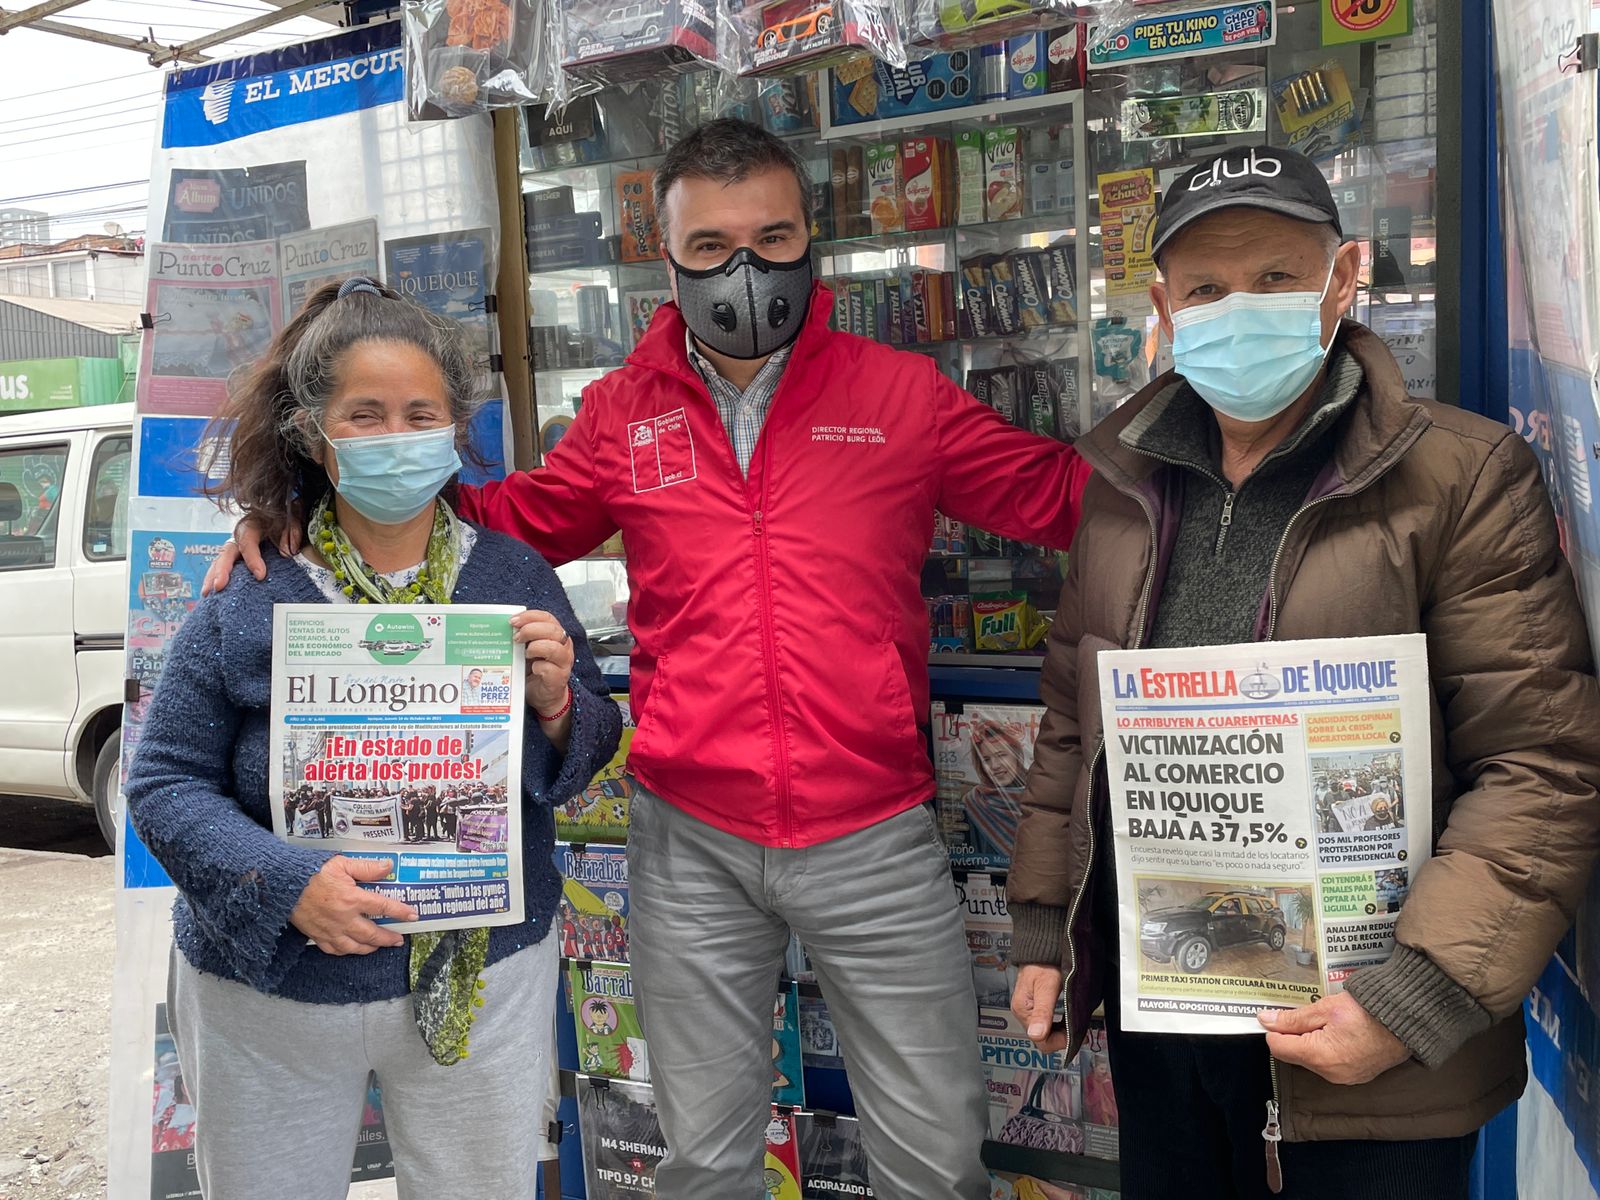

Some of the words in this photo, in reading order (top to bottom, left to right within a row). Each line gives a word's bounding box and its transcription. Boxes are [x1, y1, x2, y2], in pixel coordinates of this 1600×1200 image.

[1225, 10, 1254, 25] CHAO
[1135, 24, 1163, 39] PIDE
[1166, 21, 1182, 34] TU
[1186, 16, 1217, 31] KINO
[1228, 18, 1254, 33] JEFE
[1150, 37, 1166, 49] EN
[1169, 33, 1203, 46] CAJA
[245, 81, 279, 103] EL
[1188, 149, 1281, 191] club
[230, 181, 297, 210] UNIDOS
[633, 201, 648, 253] ROCKLETS
[400, 270, 479, 297] IQUEIQUE
[890, 290, 901, 325] HALLS
[851, 295, 862, 336] HALLS
[1032, 394, 1044, 426] ULTRA
[658, 414, 683, 427] Gobierno
[668, 423, 681, 431] Chile
[812, 426, 847, 434] DIRECTOR
[812, 434, 844, 442] PATRICIO
[868, 436, 886, 444] LEÓN
[664, 471, 682, 482] gob.cl
[981, 612, 1017, 637] Full
[1112, 669, 1139, 699] LA
[1282, 666, 1311, 694] DE
[286, 674, 316, 704] El
[328, 676, 459, 712] Longino
[1117, 718, 1131, 728] LO
[1132, 718, 1194, 728] ATRIBUYEN
[1196, 718, 1206, 728] A
[1208, 714, 1298, 727] CUARENTENAS
[1308, 715, 1360, 724] CANDIDATOS
[1361, 712, 1393, 721] OPINAN
[1308, 726, 1336, 734] SOBRE
[1348, 724, 1374, 732] CRISIS
[1119, 728, 1284, 756] VICTIMIZACIÓN
[1309, 734, 1361, 743] MIGRATORIA
[1362, 732, 1387, 740] LOCAL
[326, 736, 357, 759] ¡En
[362, 736, 432, 757] estado
[437, 736, 463, 756] de
[305, 760, 367, 781] alerta
[372, 760, 404, 781] los
[408, 759, 482, 782] profes!
[1124, 763, 1151, 783] AL
[1154, 762, 1285, 785] COMERCIO
[1126, 790, 1156, 811] EN
[1160, 792, 1265, 820] IQUIQUE
[363, 828, 395, 839] PRESENTE
[1128, 818, 1186, 841] BAJA
[1189, 821, 1207, 842] A
[1211, 822, 1288, 848] 37,5%
[1318, 836, 1336, 844] DOS
[1354, 832, 1401, 843] PROFESORES
[1130, 846, 1162, 854] Encuesta
[1184, 850, 1199, 858] que
[1214, 850, 1221, 858] la
[1223, 850, 1245, 858] mitad
[1246, 851, 1257, 859] de
[1258, 851, 1269, 859] los
[1270, 852, 1310, 860] locatarios
[1319, 844, 1376, 854] PROTESTARON
[1378, 842, 1393, 851] POR
[1132, 856, 1145, 864] dijo
[1146, 856, 1165, 864] sentir
[1166, 858, 1180, 866] que
[1190, 858, 1212, 867] barrio
[1226, 861, 1243, 870] poco
[1252, 861, 1271, 870] nada
[1342, 852, 1396, 861] PRESIDENCIAL
[1336, 876, 1367, 884] TENDRÁ
[406, 884, 441, 902] Tarapacá:
[466, 888, 471, 898] a
[471, 885, 482, 897] las
[482, 883, 506, 896] pymes
[1322, 886, 1354, 894] FINALES
[420, 902, 442, 916] fondo
[443, 900, 475, 915] regional
[476, 897, 489, 910] del
[490, 896, 507, 909] año"
[1324, 895, 1349, 903] OPTAR
[1324, 904, 1358, 913] LIGUILLA
[1326, 924, 1368, 934] ANALIZAN
[1327, 934, 1346, 943] DÍAS
[1352, 942, 1384, 951] BASURA
[1328, 962, 1359, 970] Coronavirus
[1328, 972, 1345, 980] 175
[1141, 974, 1169, 983] PRIMER
[1170, 976, 1188, 984] TAXI
[1190, 977, 1221, 986] STATION
[1222, 978, 1265, 988] CIRCULARÁ
[1266, 982, 1276, 990] EN
[1277, 983, 1287, 991] LA
[1289, 984, 1318, 994] CIUDAD
[1140, 1001, 1178, 1010] MAYORÍA
[1180, 1003, 1227, 1013] OPOSITORA
[602, 1138, 618, 1150] M4
[620, 1140, 669, 1157] SHERMAN
[597, 1168, 622, 1183] TIPO
[624, 1173, 639, 1186] 97
[808, 1178, 865, 1195] ACORAZADO
